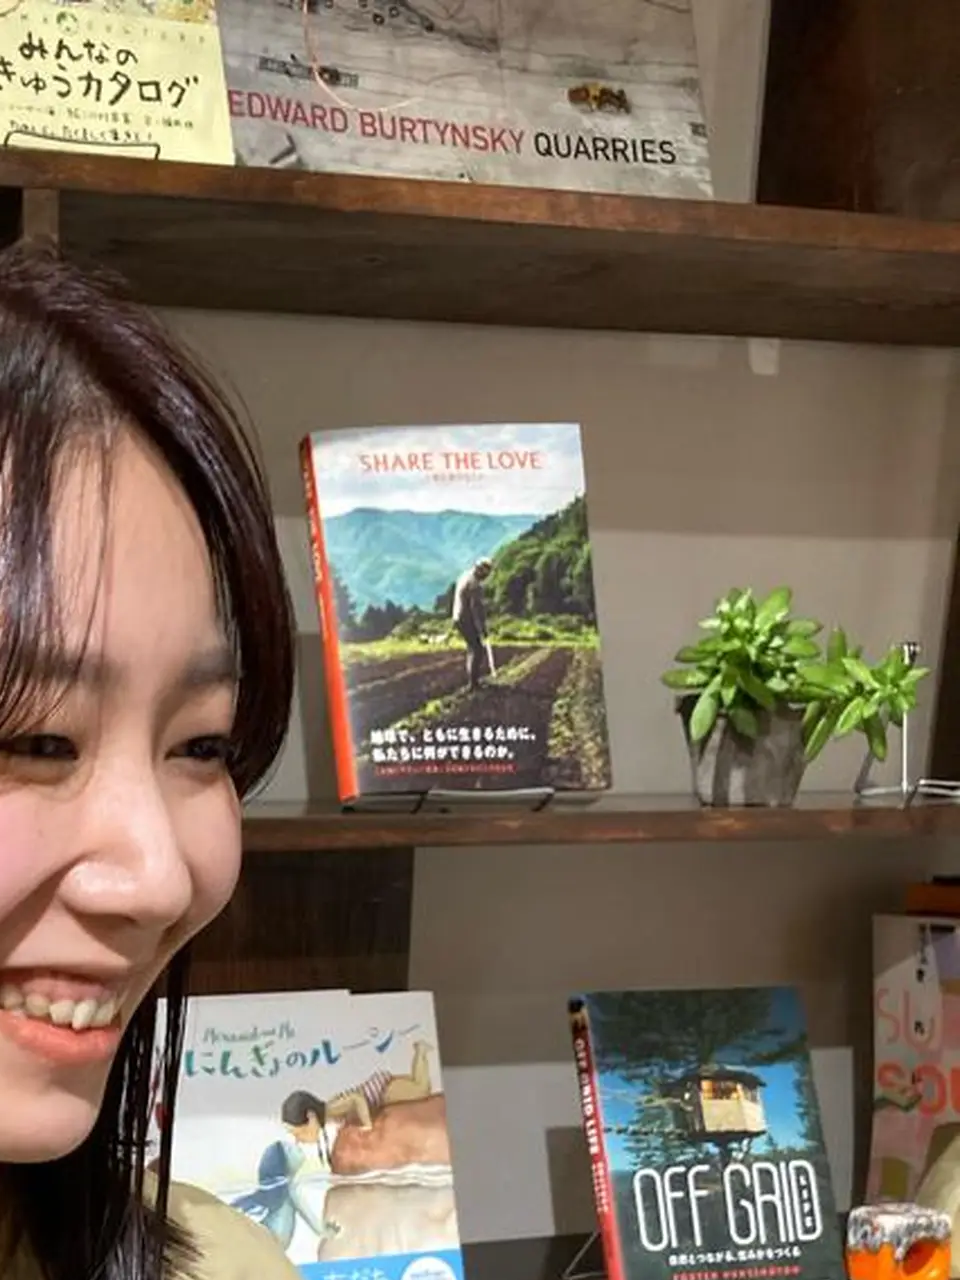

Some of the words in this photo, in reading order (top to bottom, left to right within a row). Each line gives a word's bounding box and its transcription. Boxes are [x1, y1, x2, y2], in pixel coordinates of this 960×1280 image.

[18, 31, 138, 67] みんなの
[228, 90, 349, 134] EDWARD
[359, 111, 524, 154] BURTYNSKY
[534, 131, 677, 165] QUARRIES
[359, 453, 433, 473] SHARE
[442, 451, 482, 471] THE
[487, 450, 543, 471] LOVE
[184, 1023, 421, 1079] にんぎょのルーシー
[633, 1164, 711, 1251] OFF
[723, 1159, 823, 1246] GRID
